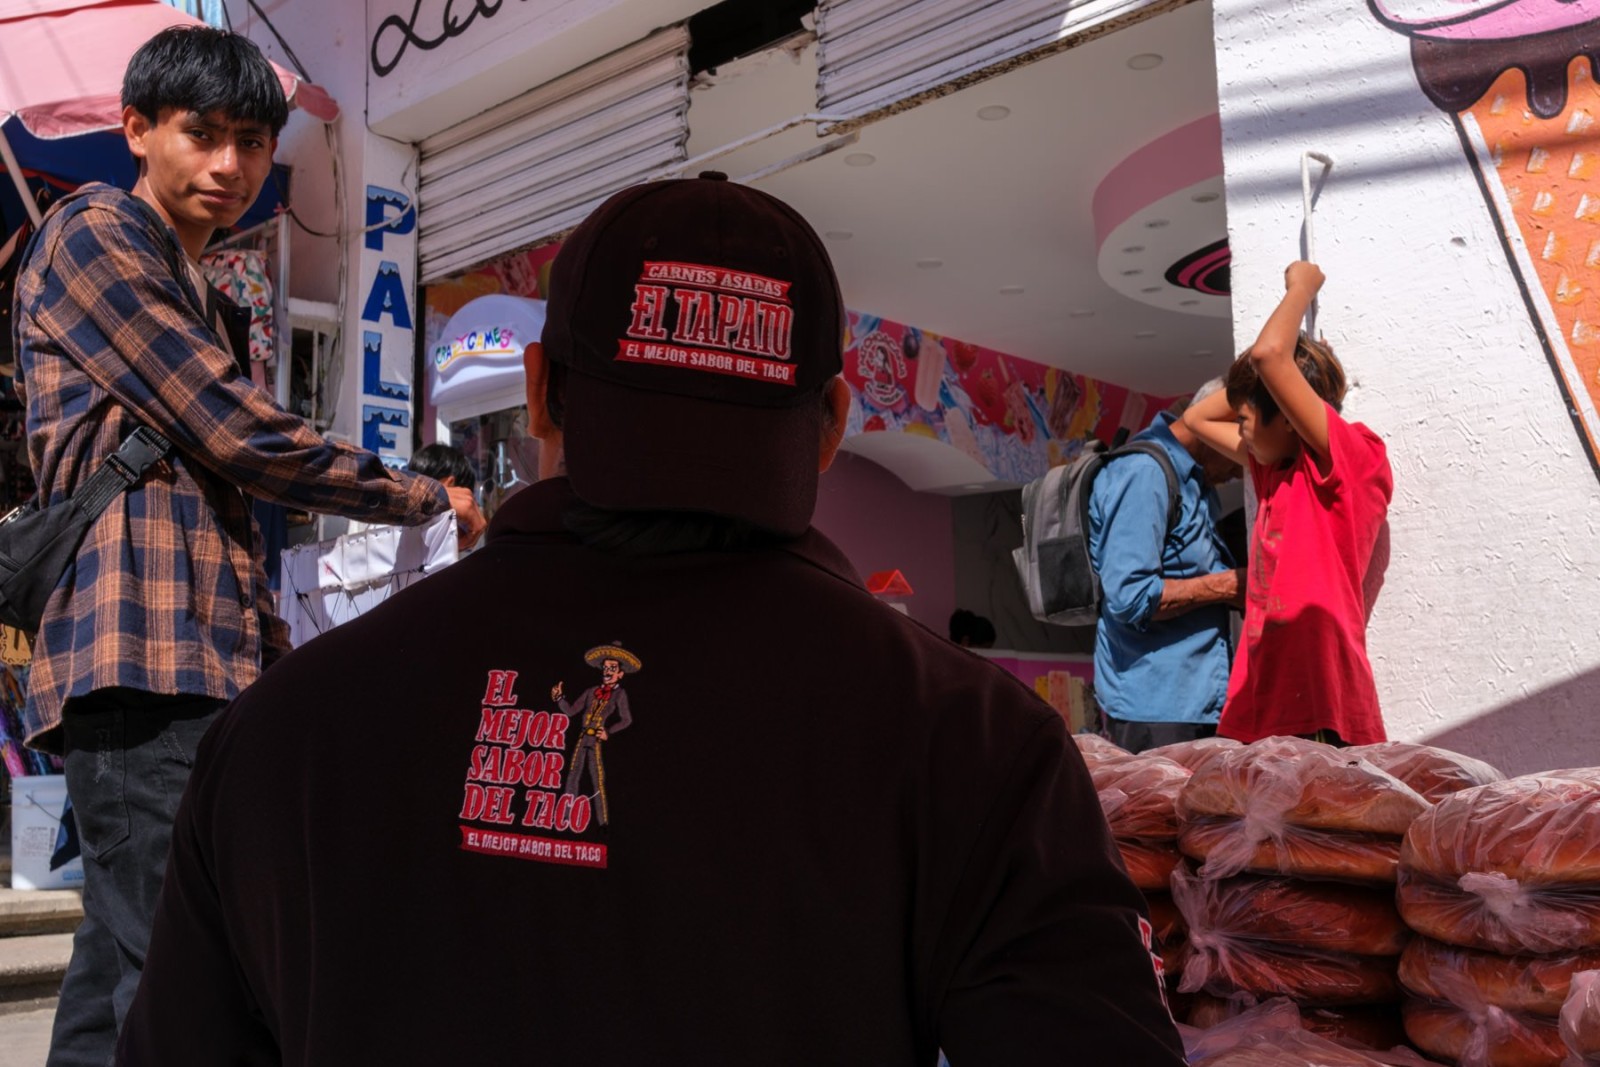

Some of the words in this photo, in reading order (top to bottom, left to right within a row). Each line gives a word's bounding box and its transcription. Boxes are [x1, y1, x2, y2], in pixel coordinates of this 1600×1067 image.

[648, 265, 717, 285] CARNES
[720, 273, 783, 298] ASADAS
[626, 284, 670, 341] EL
[626, 343, 640, 359] EL
[643, 345, 688, 364] MEJOR
[690, 352, 733, 372] SABOR
[736, 359, 758, 376] DEL
[762, 364, 790, 381] TACO
[482, 669, 519, 706] EL
[475, 708, 570, 750] MEJOR
[466, 745, 565, 789] SABOR
[459, 783, 519, 826] DEL
[521, 789, 592, 834] TACO
[467, 832, 481, 847] EL
[482, 834, 518, 852] MEJOR
[519, 838, 552, 857] SABOR
[554, 843, 574, 860] DEL
[575, 845, 602, 863] TACO
